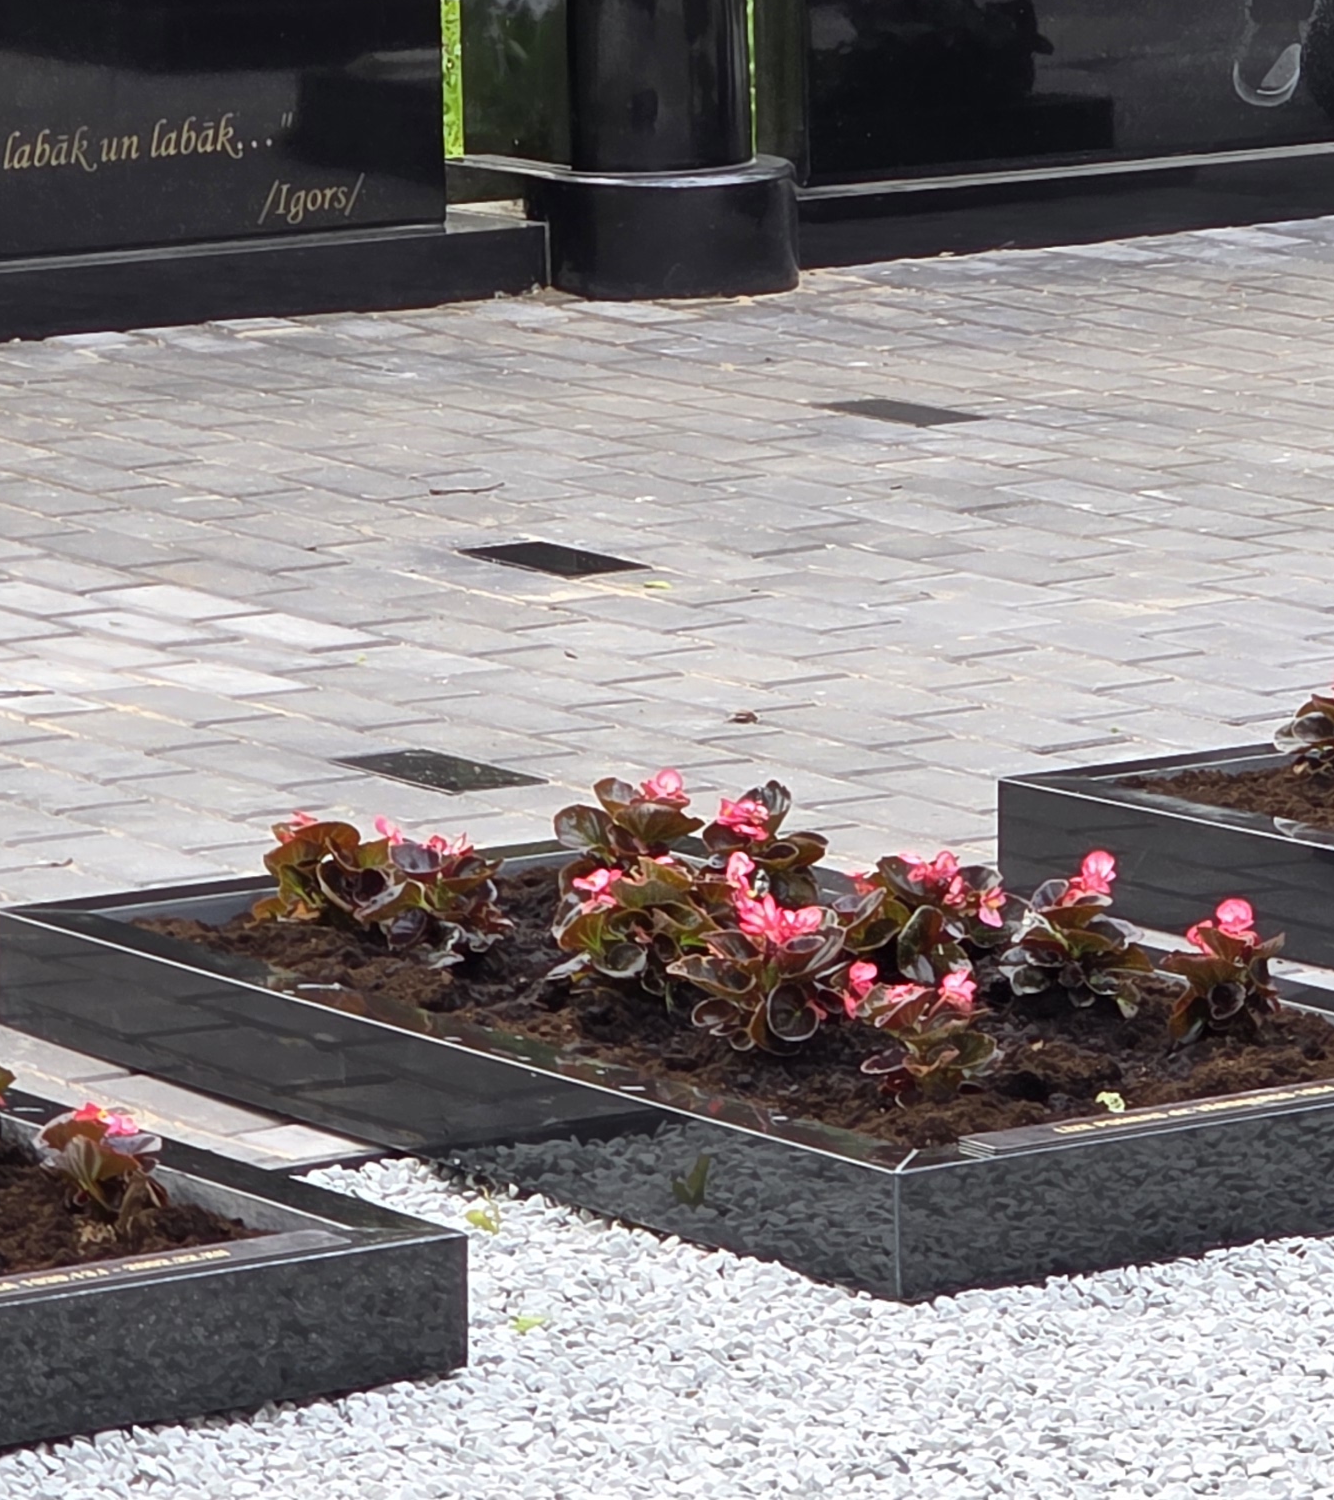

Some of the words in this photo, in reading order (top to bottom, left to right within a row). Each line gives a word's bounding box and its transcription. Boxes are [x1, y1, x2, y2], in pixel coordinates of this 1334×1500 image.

[3, 125, 97, 172] labāk
[100, 133, 140, 162] un
[257, 172, 365, 225] /Igors/
